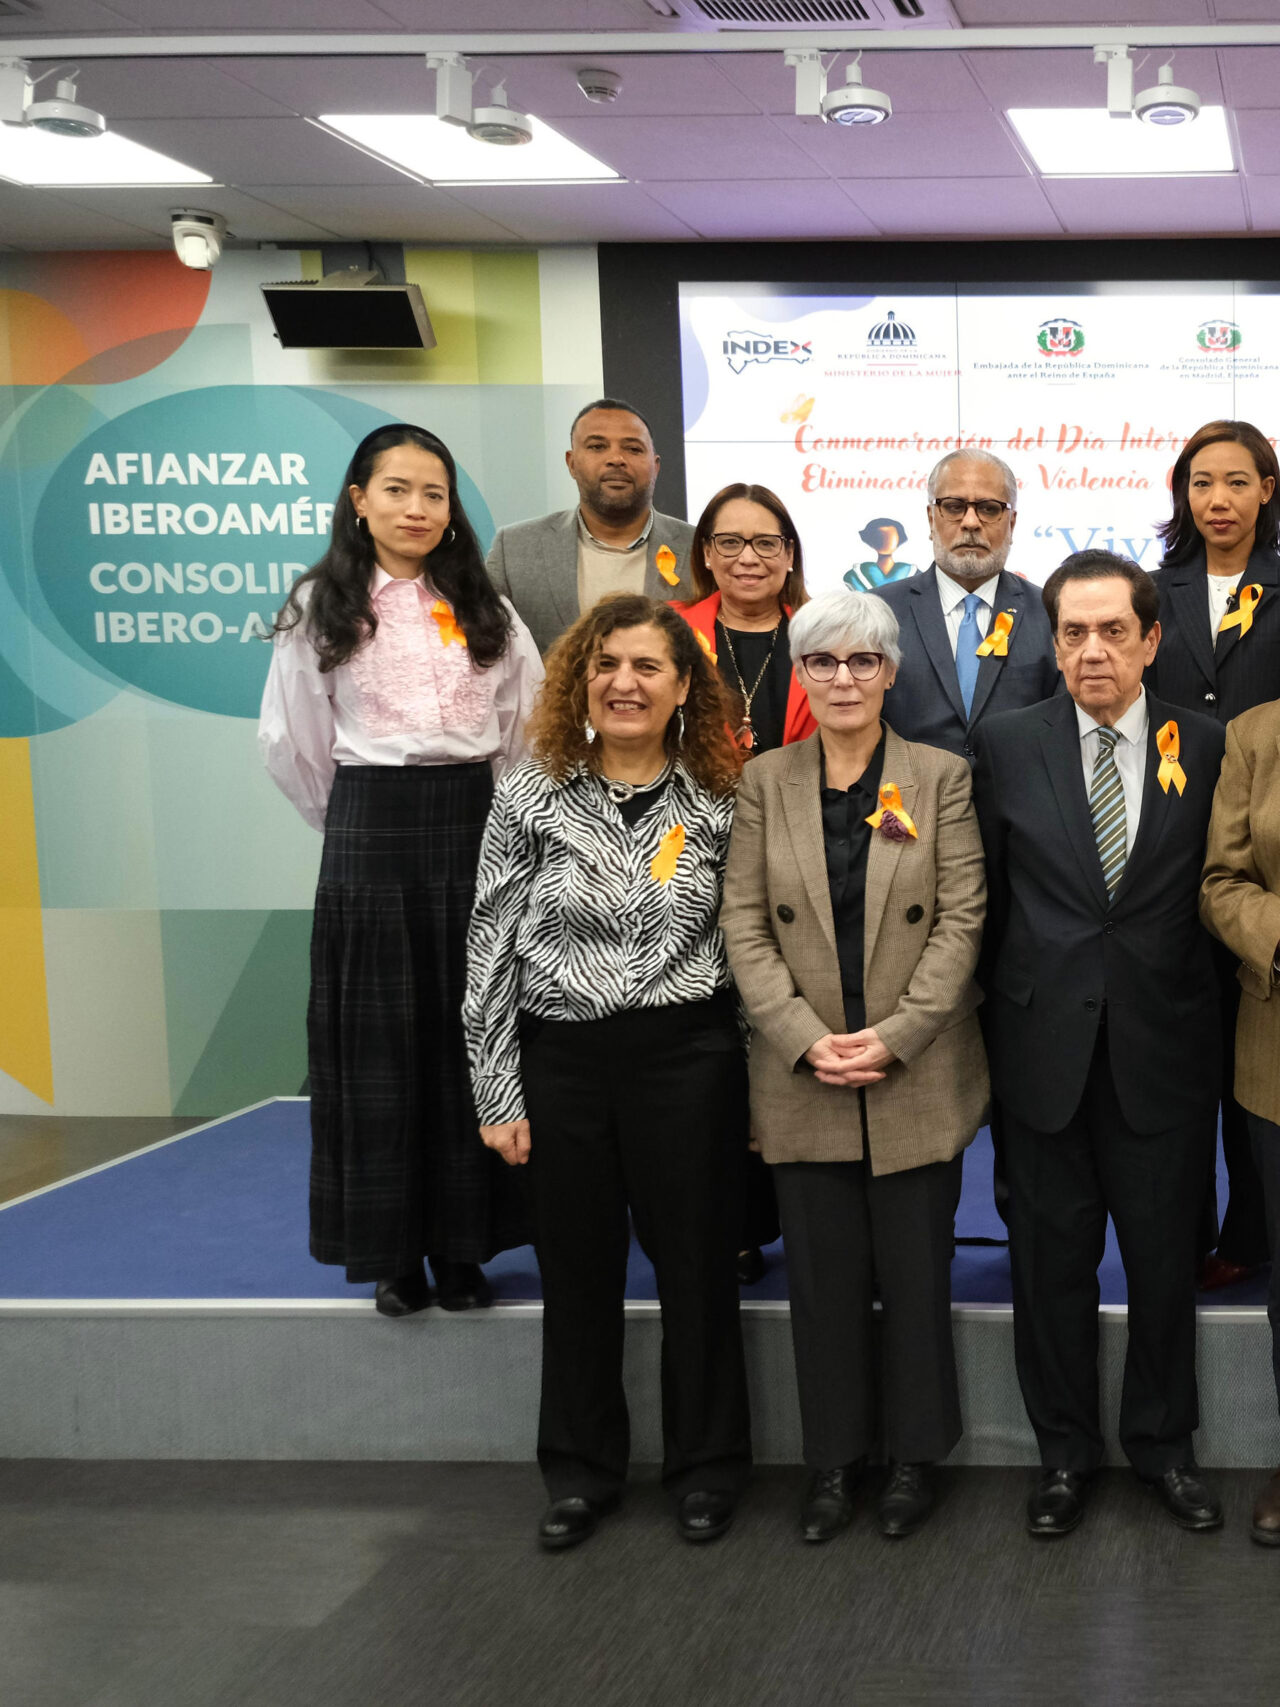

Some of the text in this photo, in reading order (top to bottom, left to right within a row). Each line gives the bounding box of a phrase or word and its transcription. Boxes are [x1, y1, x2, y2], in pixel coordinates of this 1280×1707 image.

[722, 340, 812, 355] INDEX
[892, 369, 906, 377] DE
[908, 369, 923, 377] LA
[973, 362, 1019, 370] Embajada
[1083, 372, 1116, 380] España
[794, 424, 995, 453] Conmemoración
[1006, 426, 1046, 450] del
[1056, 423, 1108, 453] Día
[84, 452, 309, 485] AFIANZAR
[801, 462, 928, 493] Eliminació
[1037, 464, 1150, 491] Violencia
[88, 497, 338, 535] IBEROAMÉR
[89, 562, 309, 594] CONSOLID
[94, 611, 277, 644] IBERO-A
